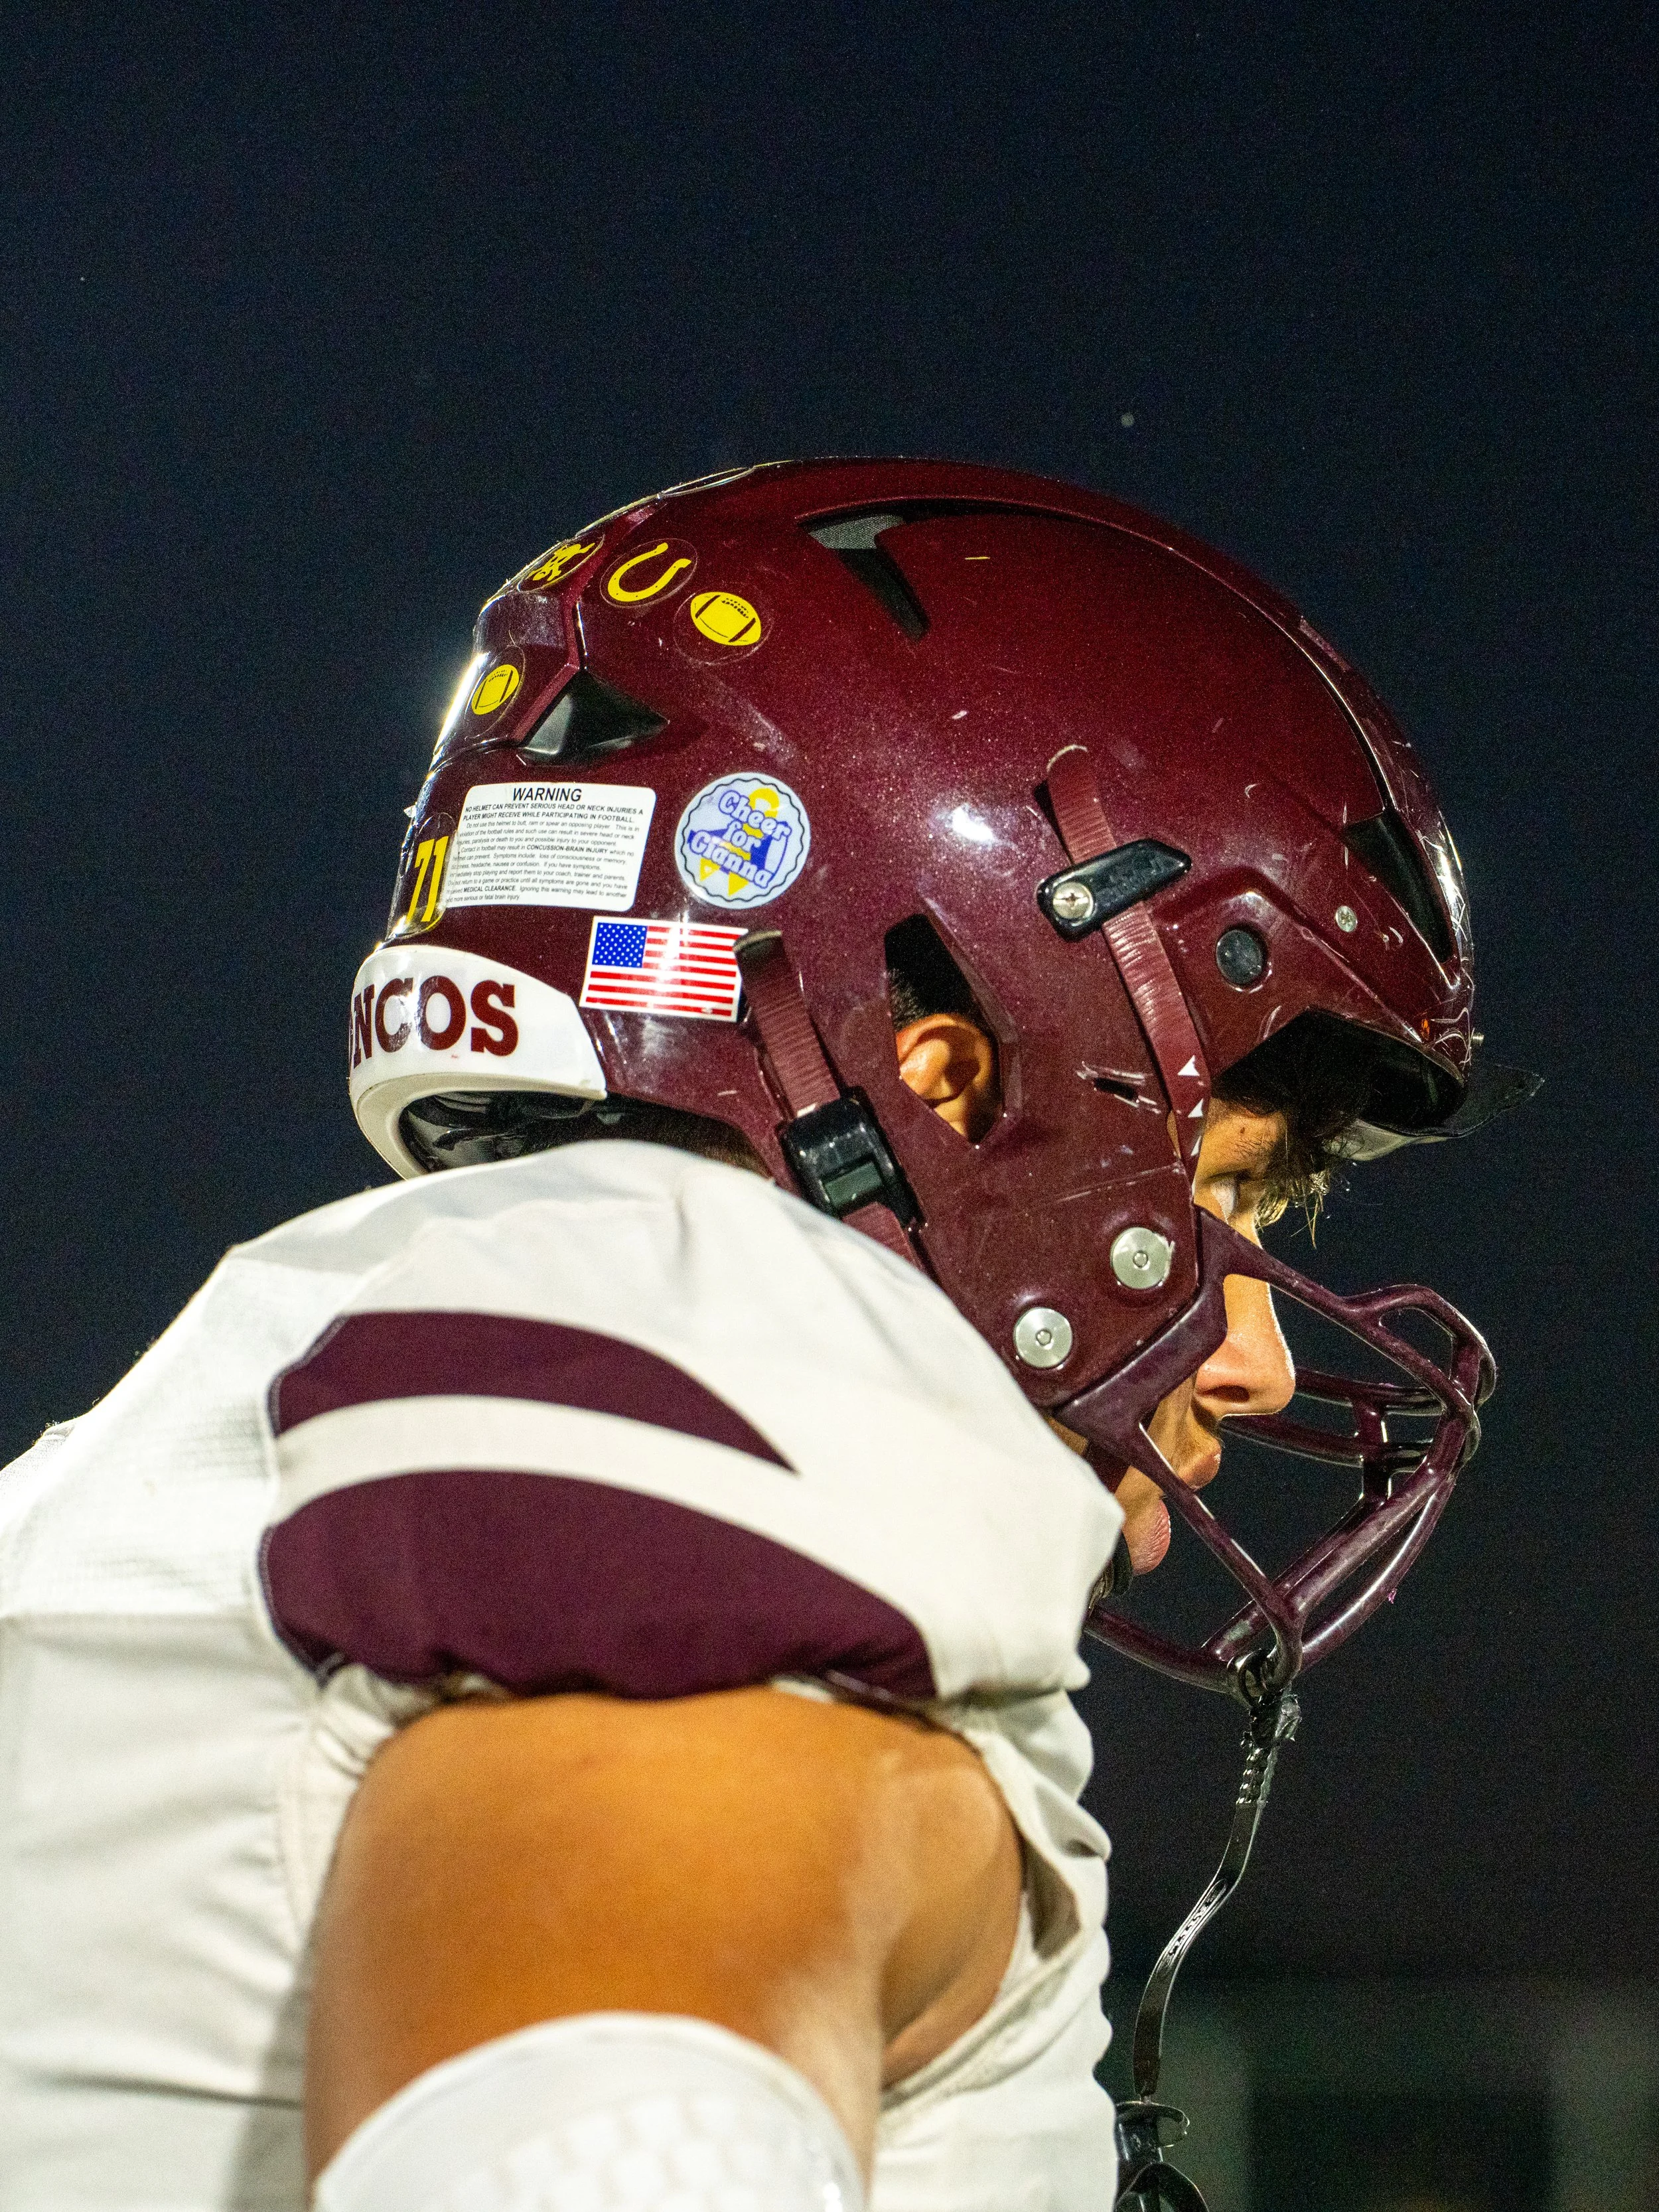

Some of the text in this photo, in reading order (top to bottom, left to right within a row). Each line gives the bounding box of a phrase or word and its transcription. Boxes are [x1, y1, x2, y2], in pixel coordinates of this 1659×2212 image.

[513, 787, 582, 802] WARNING
[719, 790, 792, 841] Cheer
[723, 819, 761, 853] for
[405, 836, 449, 924] 71
[350, 975, 519, 1069] NCOS
